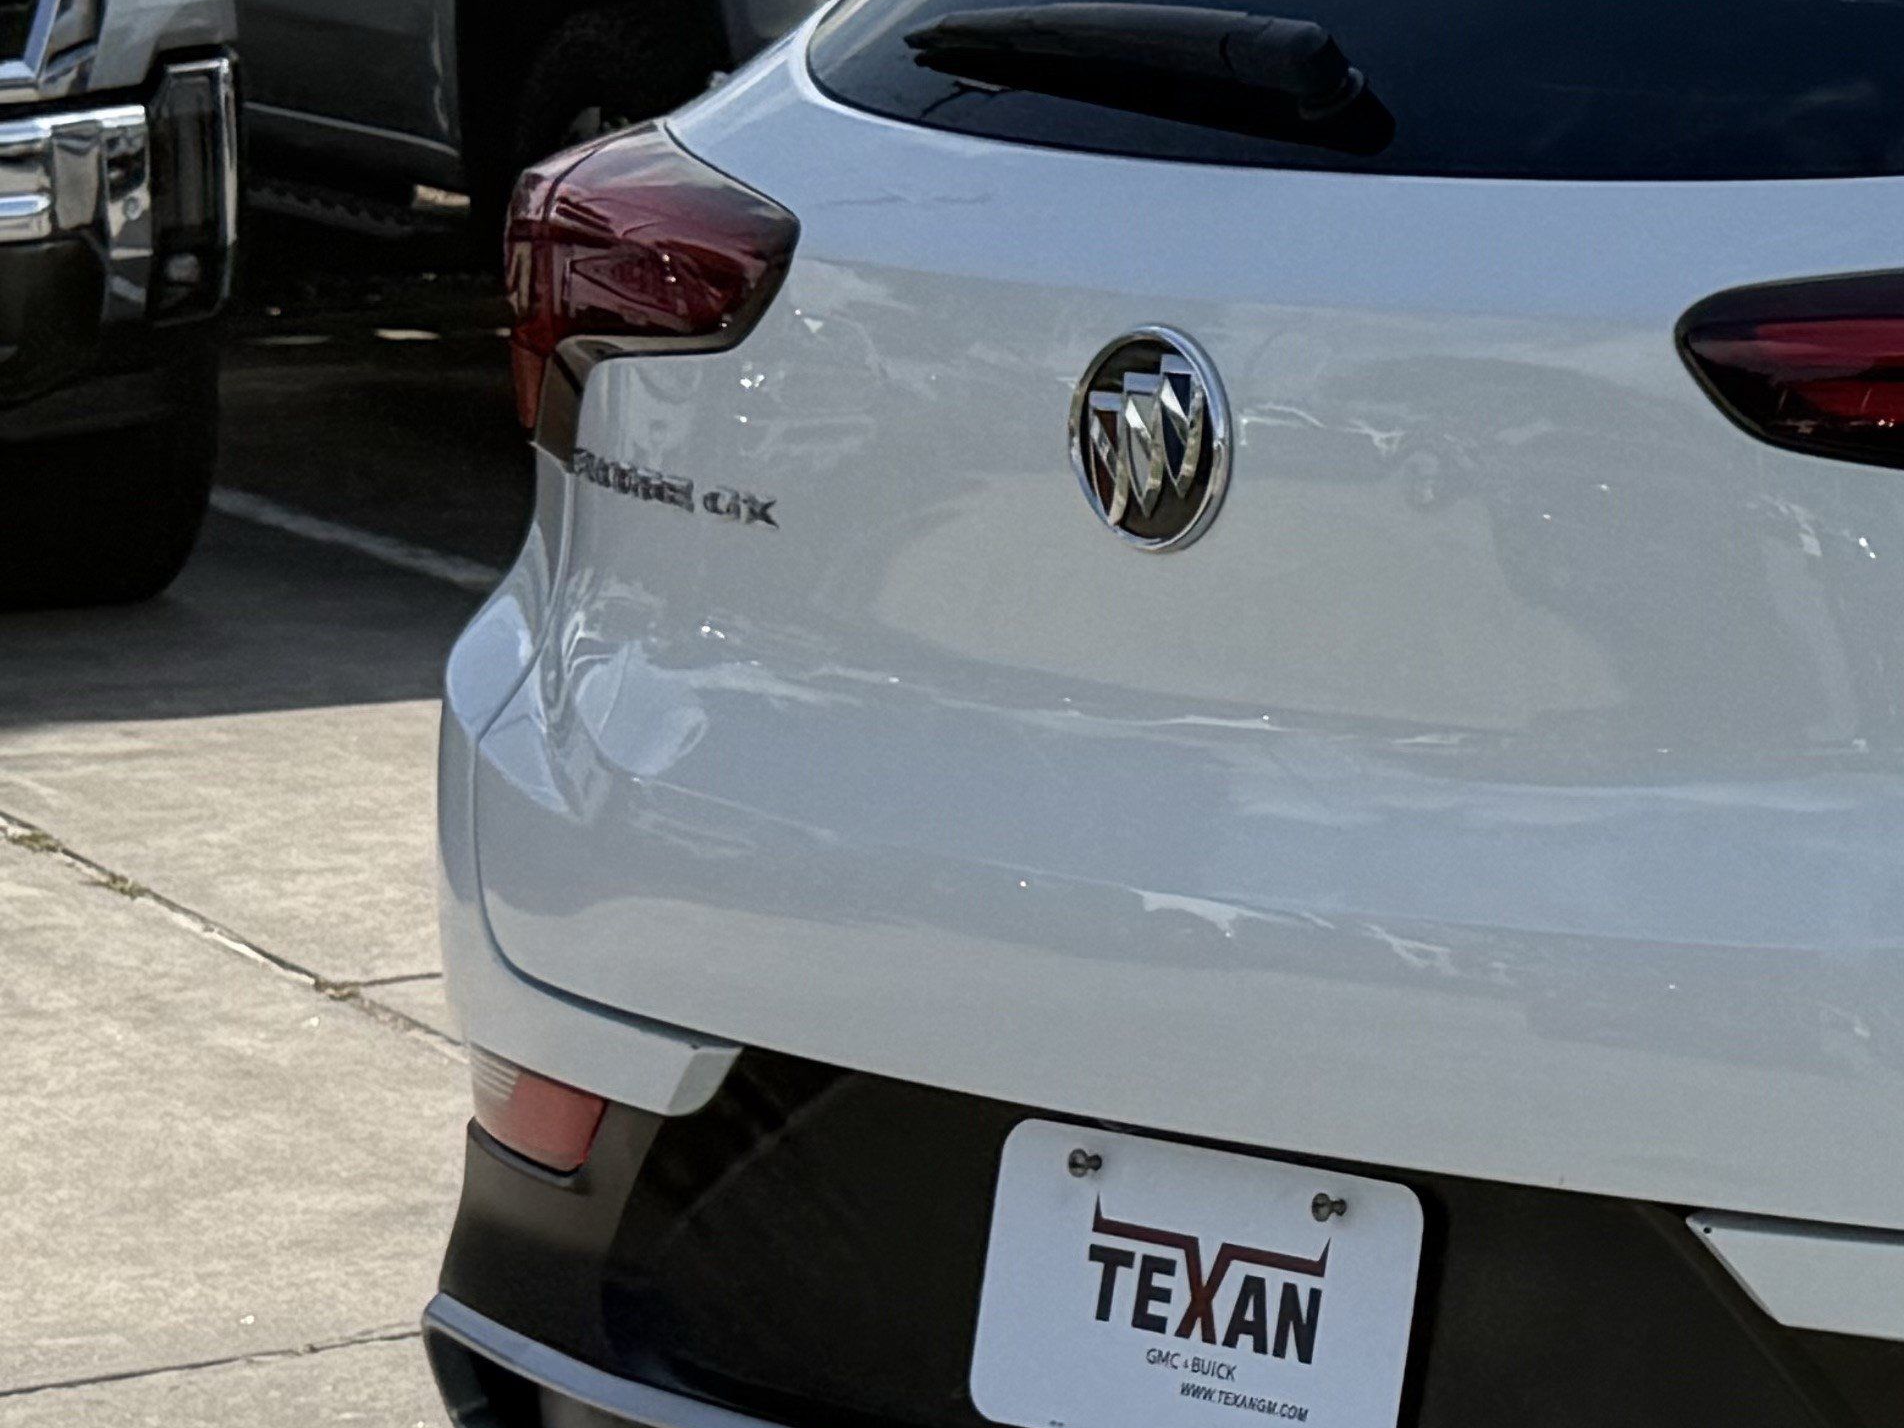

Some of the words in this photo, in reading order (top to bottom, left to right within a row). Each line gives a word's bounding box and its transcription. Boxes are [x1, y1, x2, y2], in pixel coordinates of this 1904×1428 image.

[1088, 1222, 1328, 1365] TEXAN
[1146, 1348, 1181, 1370] GMC
[1191, 1356, 1238, 1383] BUICK
[1180, 1382, 1309, 1423] WWW.TEXANGM.COM
